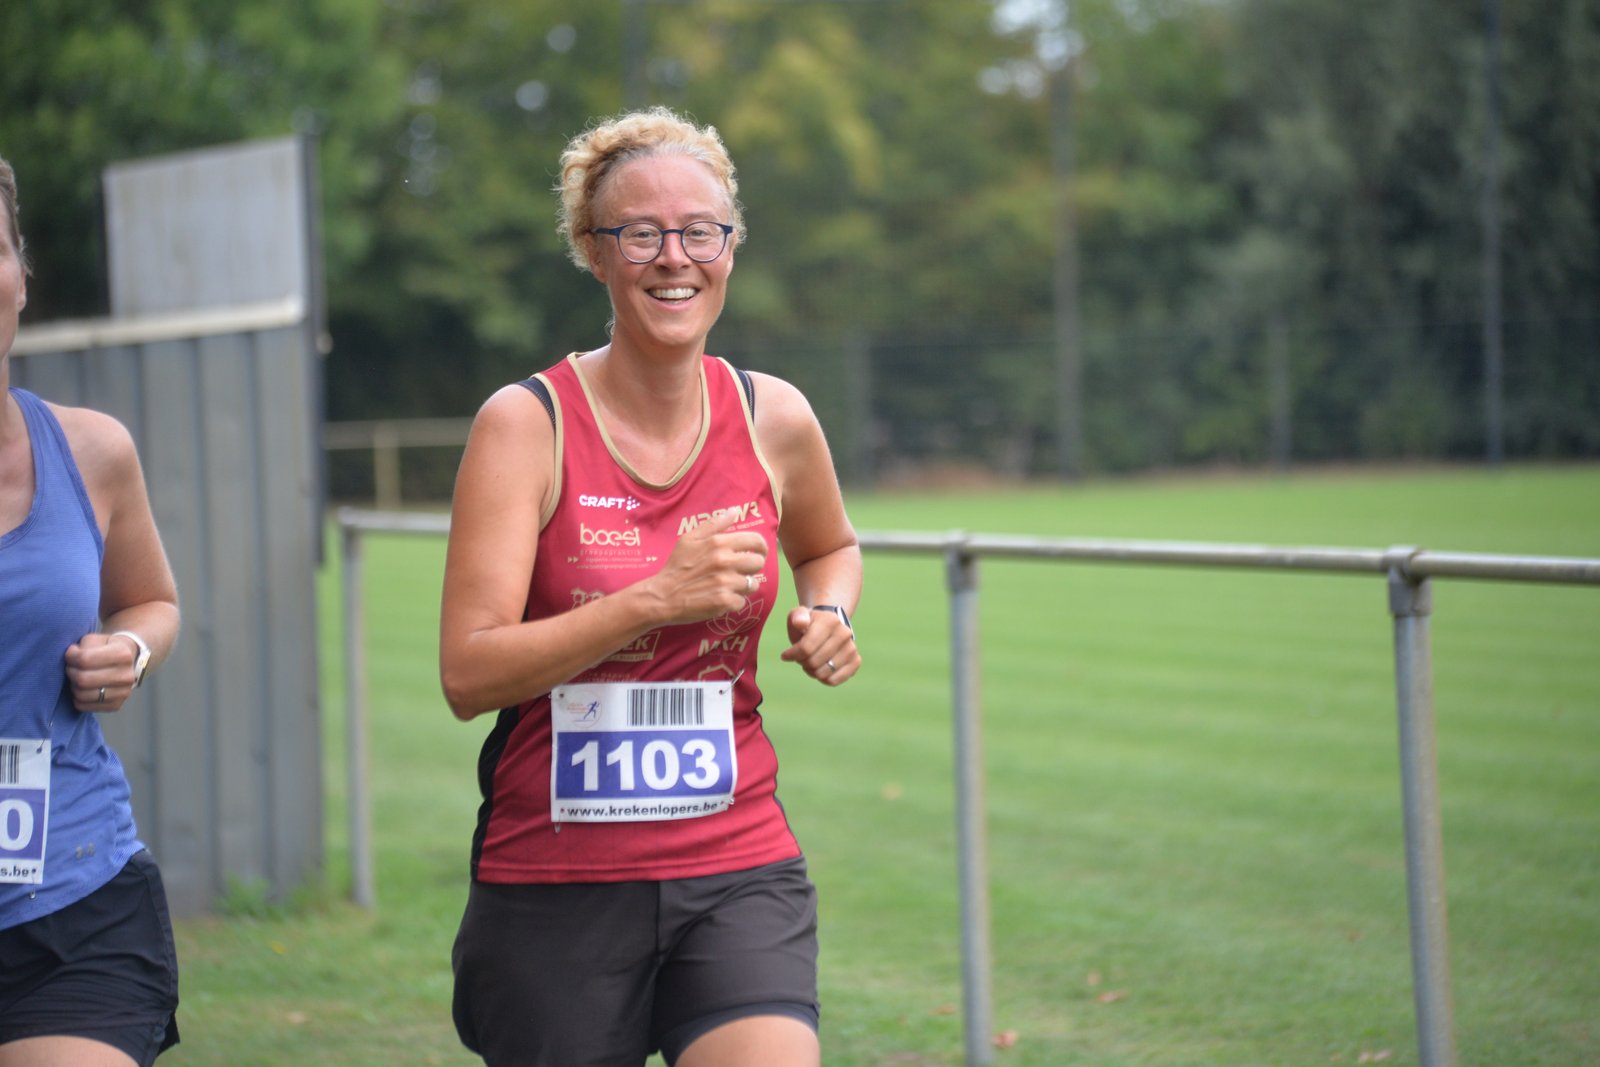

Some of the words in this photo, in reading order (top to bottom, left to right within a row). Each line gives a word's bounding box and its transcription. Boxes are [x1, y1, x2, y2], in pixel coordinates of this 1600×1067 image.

[578, 494, 626, 509] CRAFT
[571, 739, 721, 792] 1103
[567, 801, 718, 817] www.krekenlopers.be
